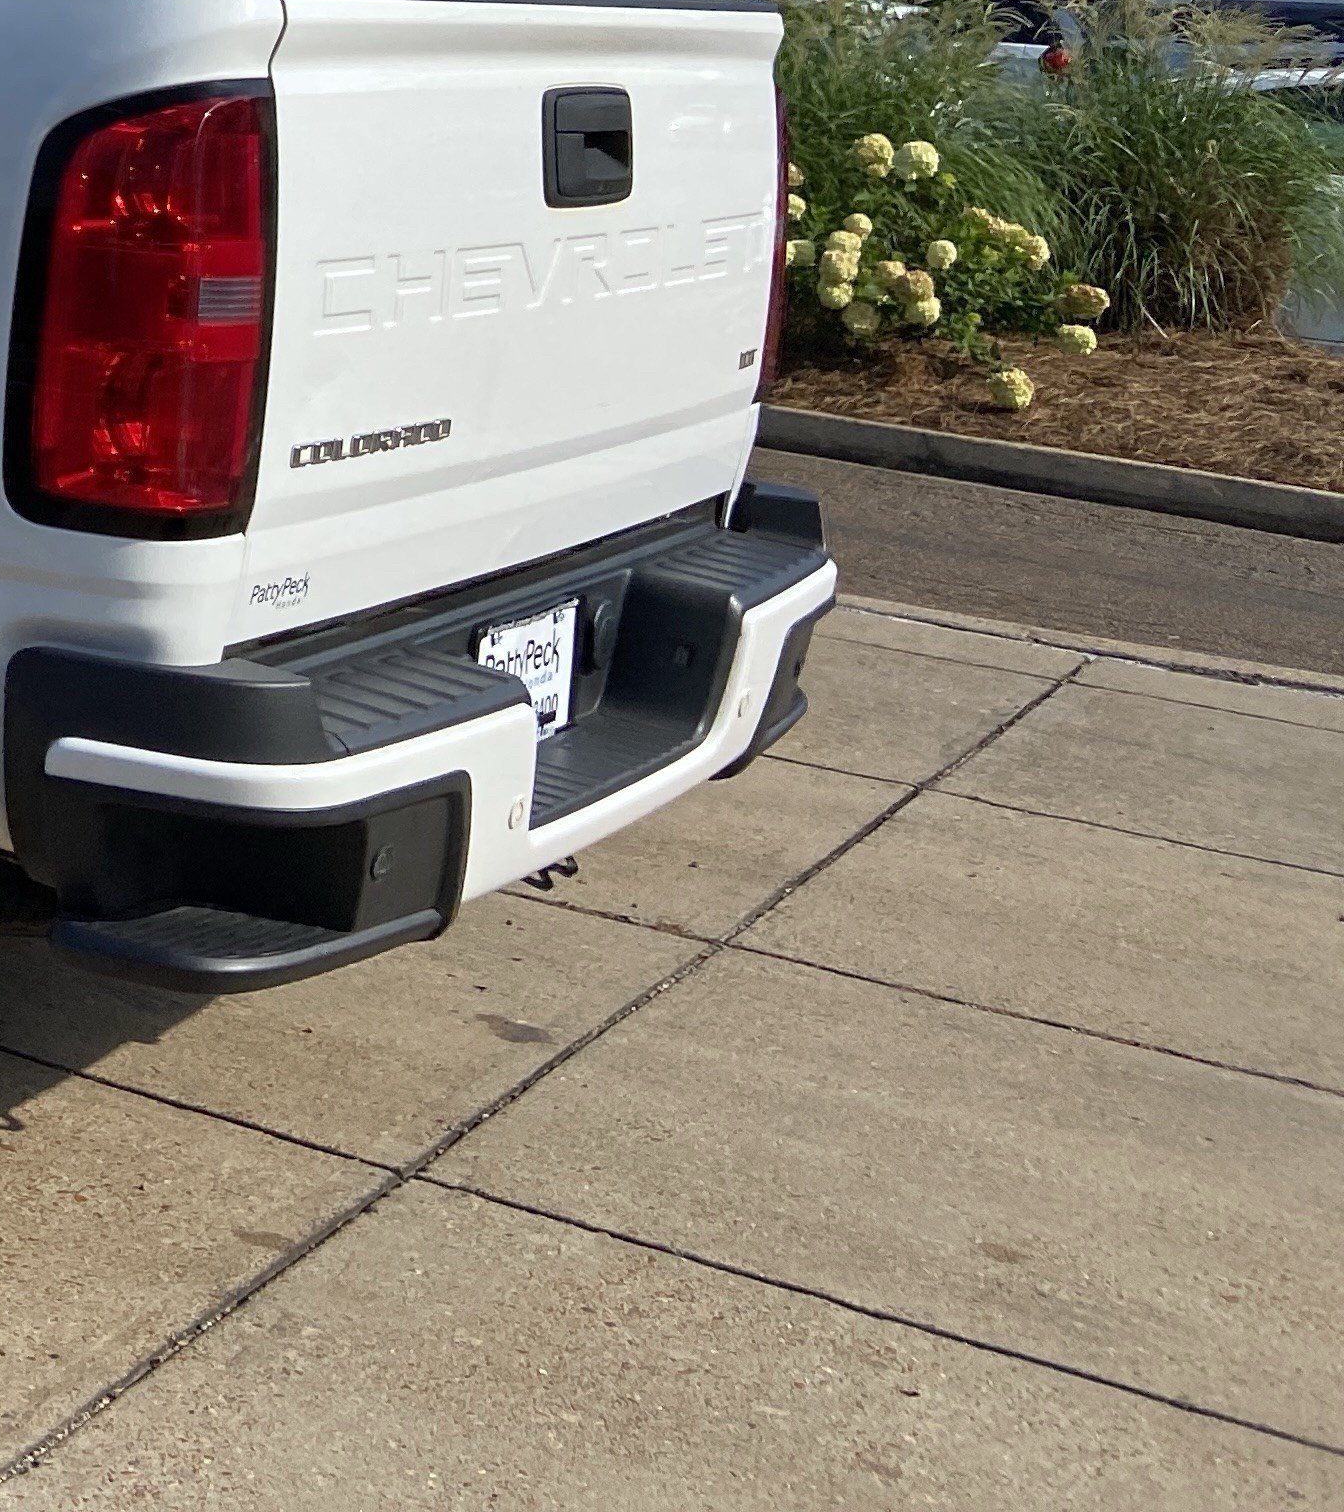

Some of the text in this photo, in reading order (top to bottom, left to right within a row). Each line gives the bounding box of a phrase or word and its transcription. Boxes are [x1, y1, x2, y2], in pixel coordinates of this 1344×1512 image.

[313, 207, 772, 336] CHEVROLET
[289, 417, 452, 469] COLORADO
[248, 571, 311, 606] PattyPeck
[525, 671, 554, 690] onda
